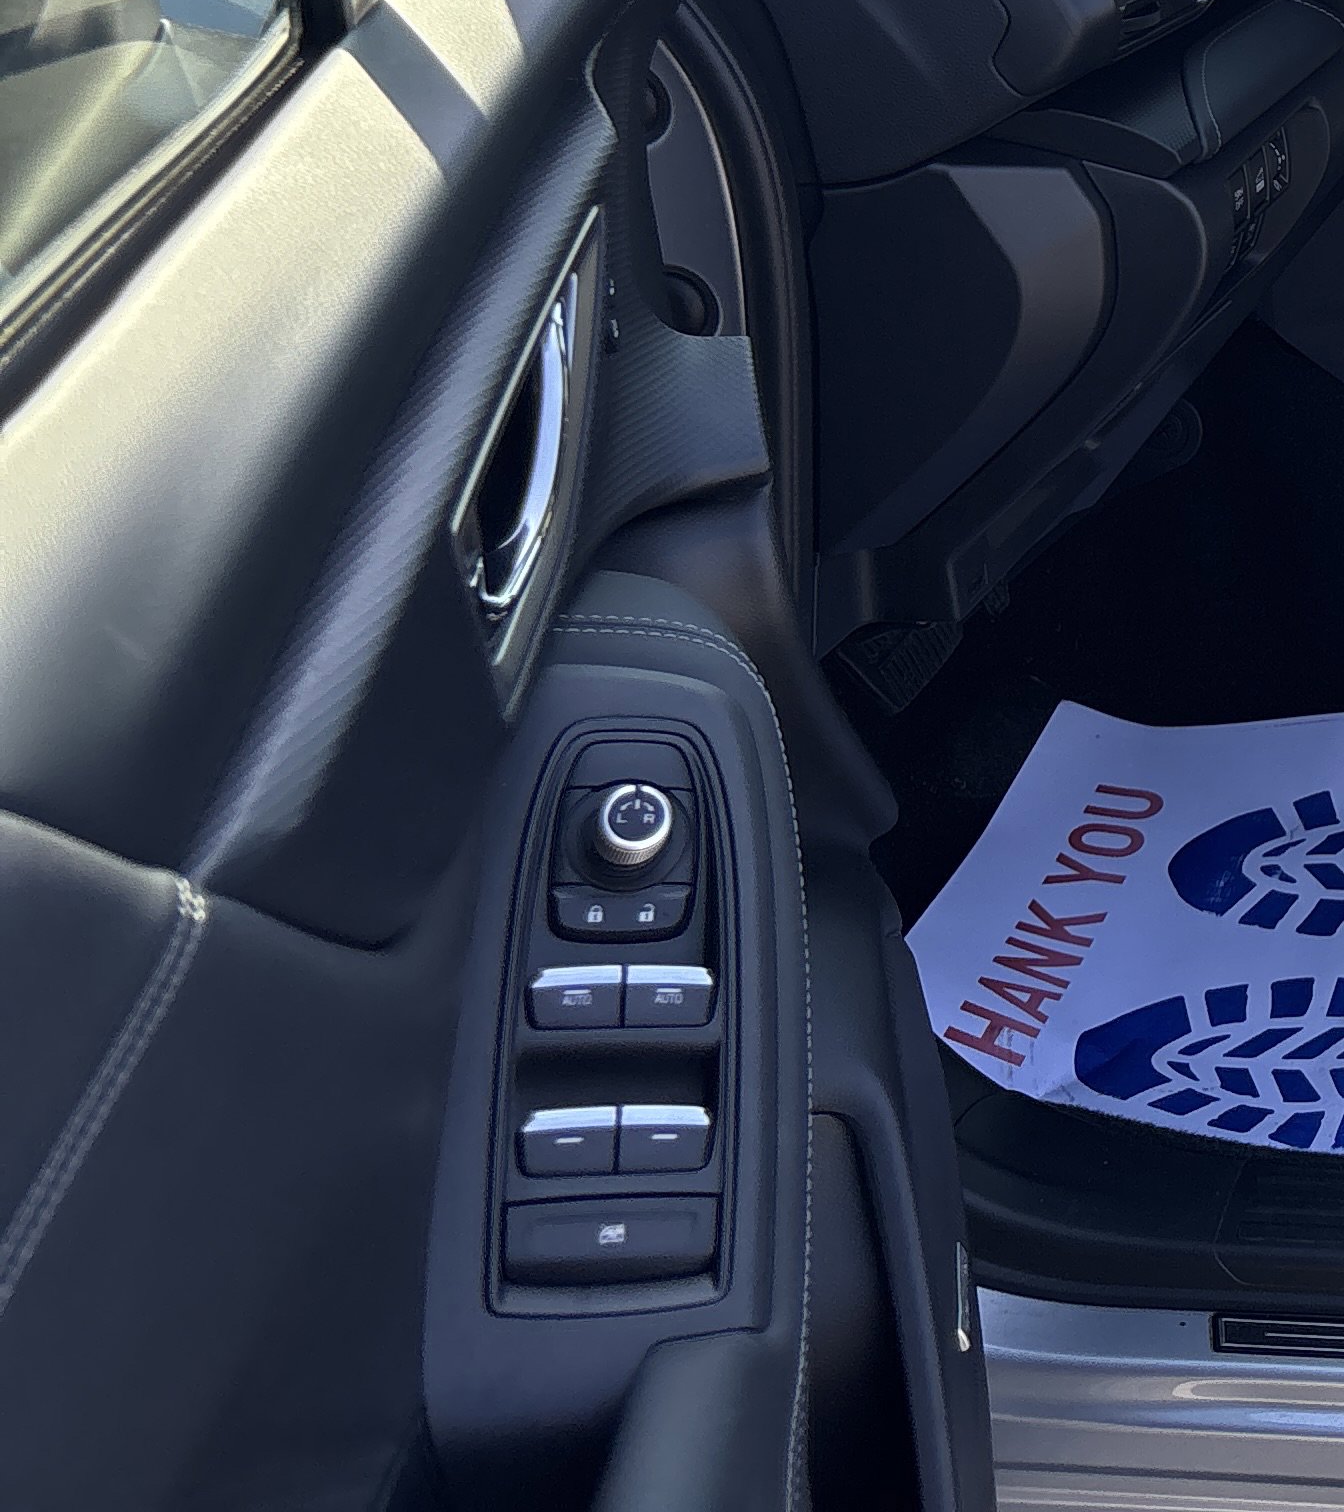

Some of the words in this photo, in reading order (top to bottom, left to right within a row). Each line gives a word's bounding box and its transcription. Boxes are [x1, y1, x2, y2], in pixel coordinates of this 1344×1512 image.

[616, 812, 628, 824] L
[642, 813, 656, 824] R
[942, 898, 1109, 1068] HANK
[1041, 783, 1165, 885] YOU
[561, 994, 593, 1006] AUTO
[654, 992, 684, 1005] AUTO
